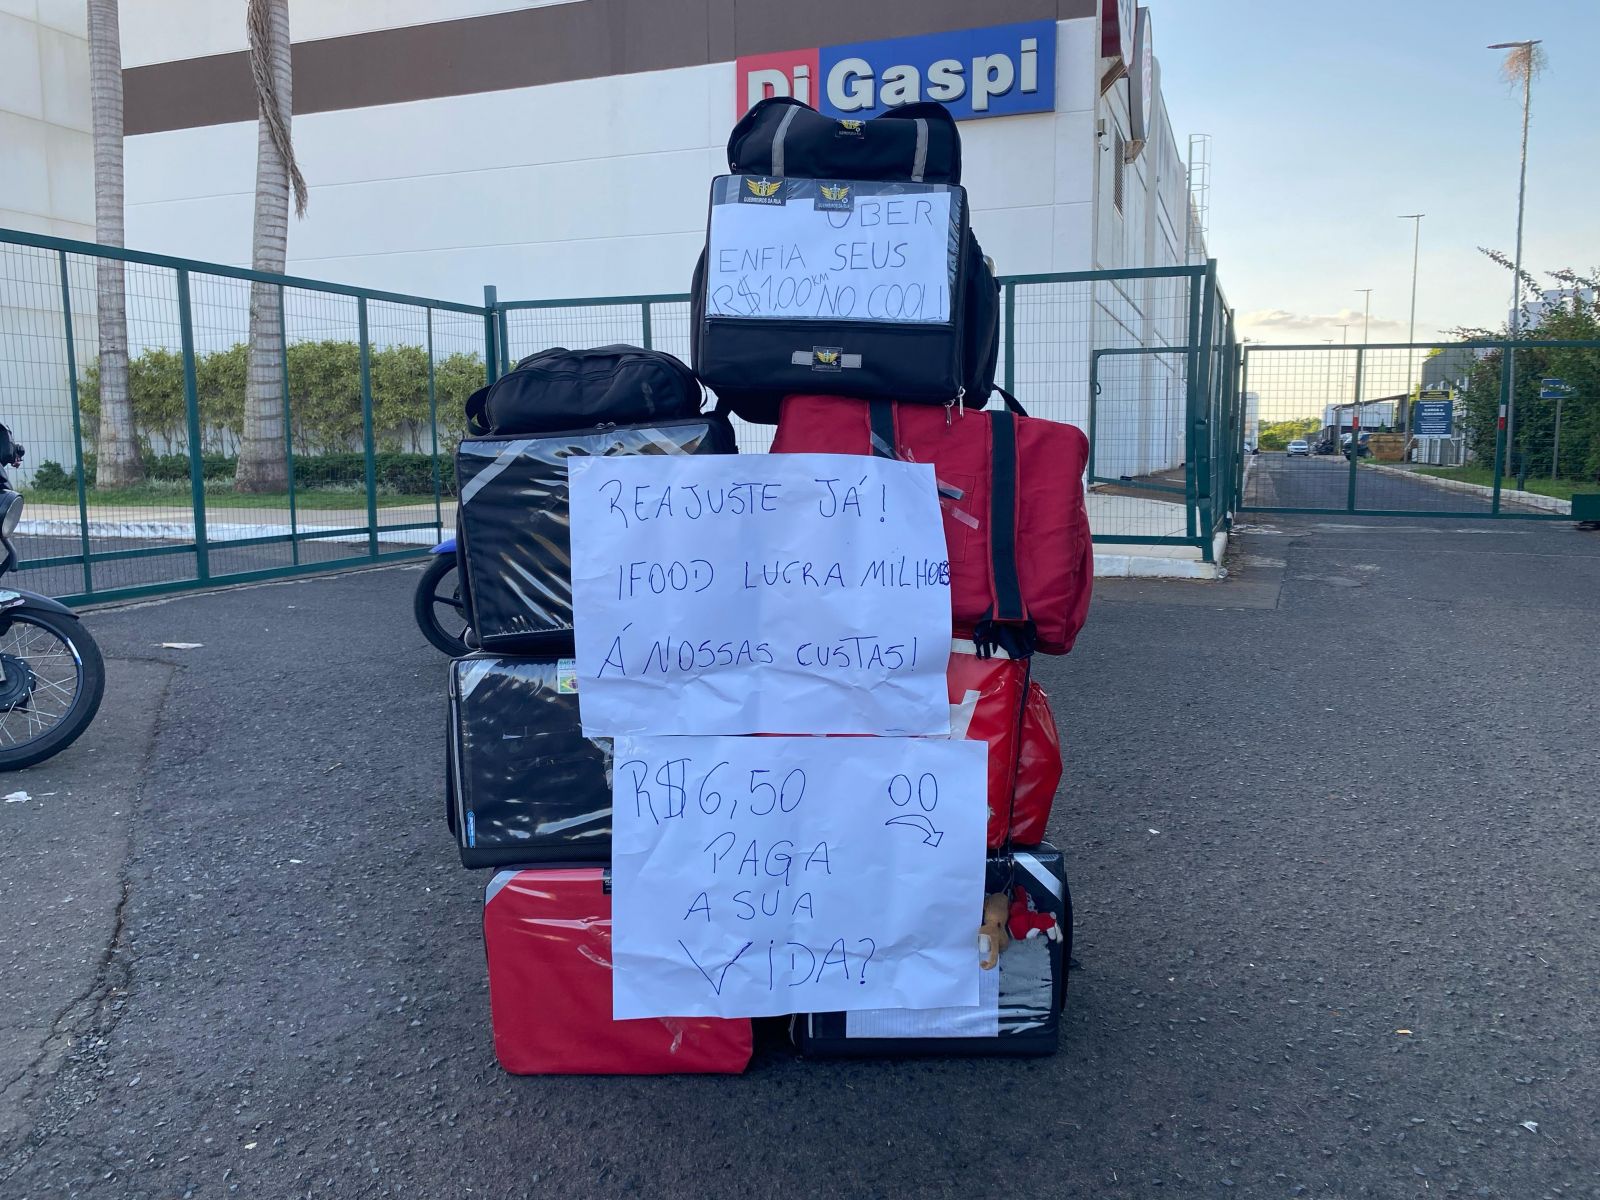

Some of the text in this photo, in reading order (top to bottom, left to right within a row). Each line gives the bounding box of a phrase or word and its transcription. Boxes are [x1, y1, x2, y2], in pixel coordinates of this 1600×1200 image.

[747, 38, 1038, 111] Di Gaspi
[829, 242, 909, 271] SEUS
[816, 283, 856, 317] NO
[599, 475, 887, 528] REAJUSTE JÁ!
[617, 559, 714, 600] IFOOD
[744, 561, 845, 589] LUCRA
[597, 623, 917, 679] Á NOSSAS CUSTAS!
[620, 758, 806, 825] R$6,50
[704, 831, 832, 886] PAGA
[684, 890, 814, 922] A SUA
